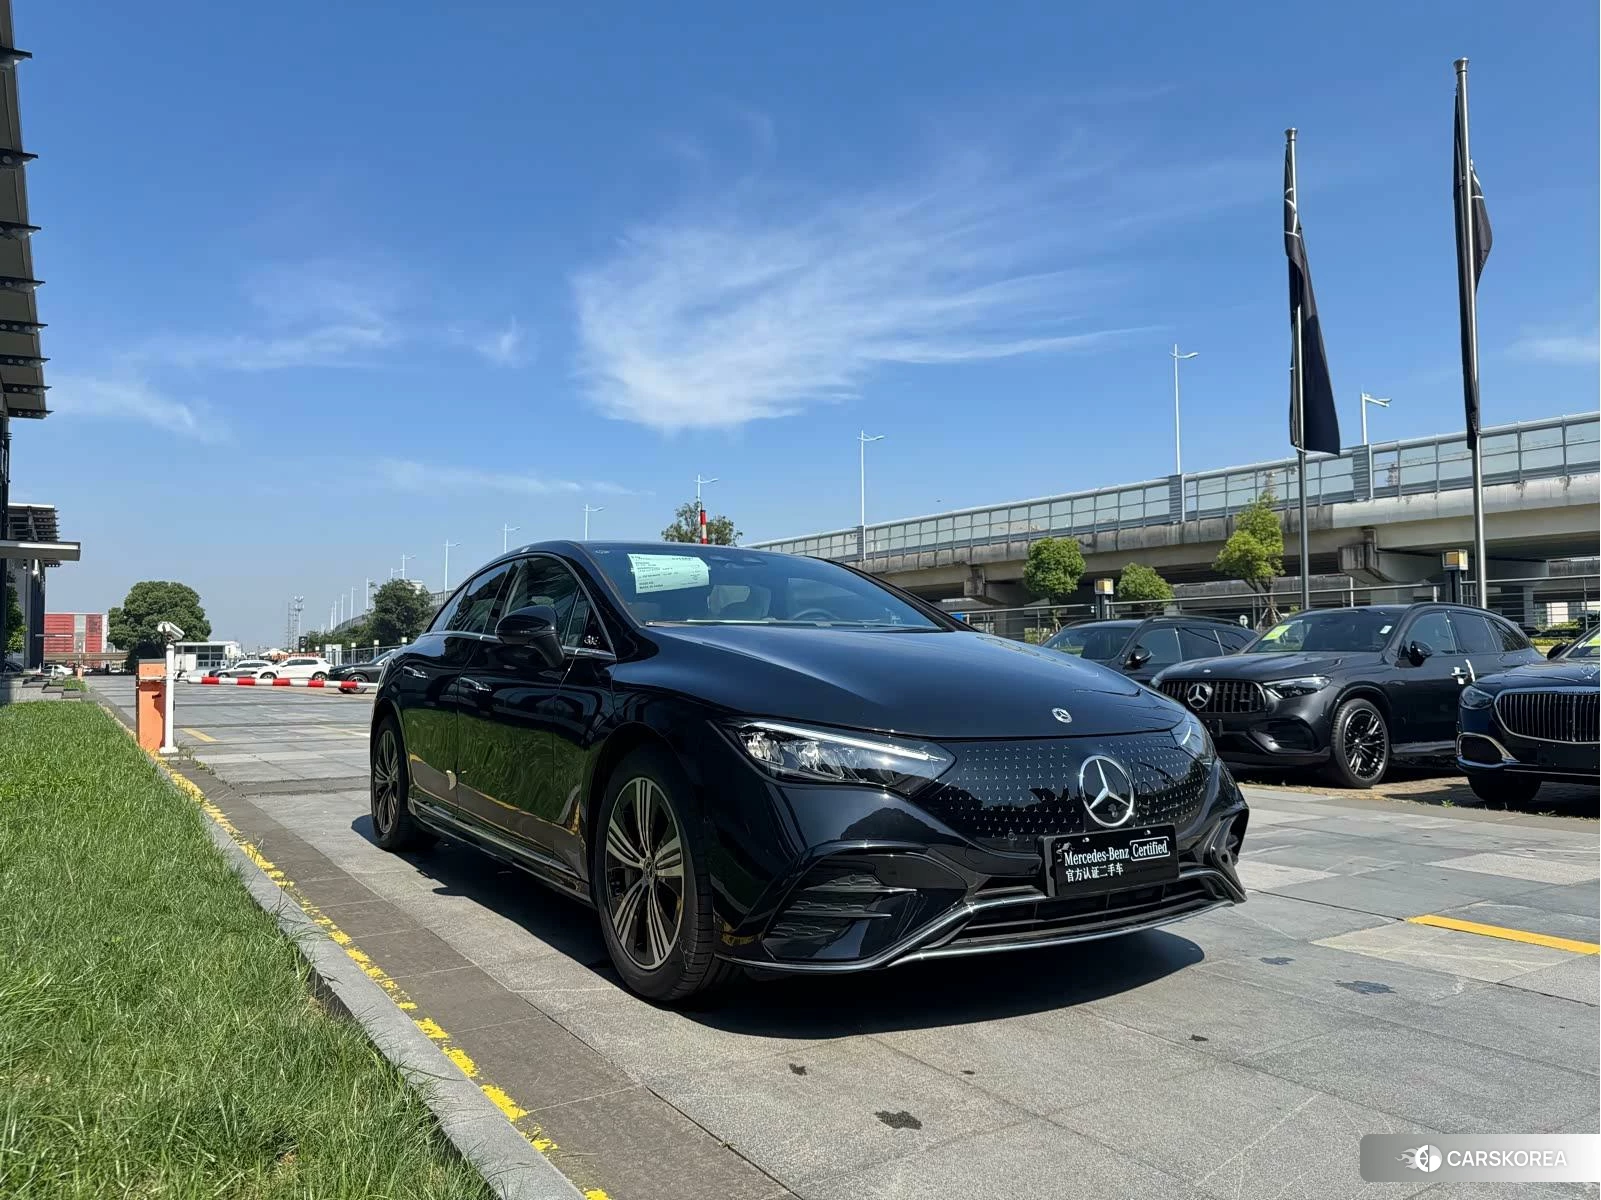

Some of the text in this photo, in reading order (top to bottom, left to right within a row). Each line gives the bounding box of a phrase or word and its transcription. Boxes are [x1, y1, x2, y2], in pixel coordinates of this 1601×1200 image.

[1064, 840, 1168, 866] Mercedes-Benz Certified
[1065, 862, 1124, 883] 官方认证二手车
